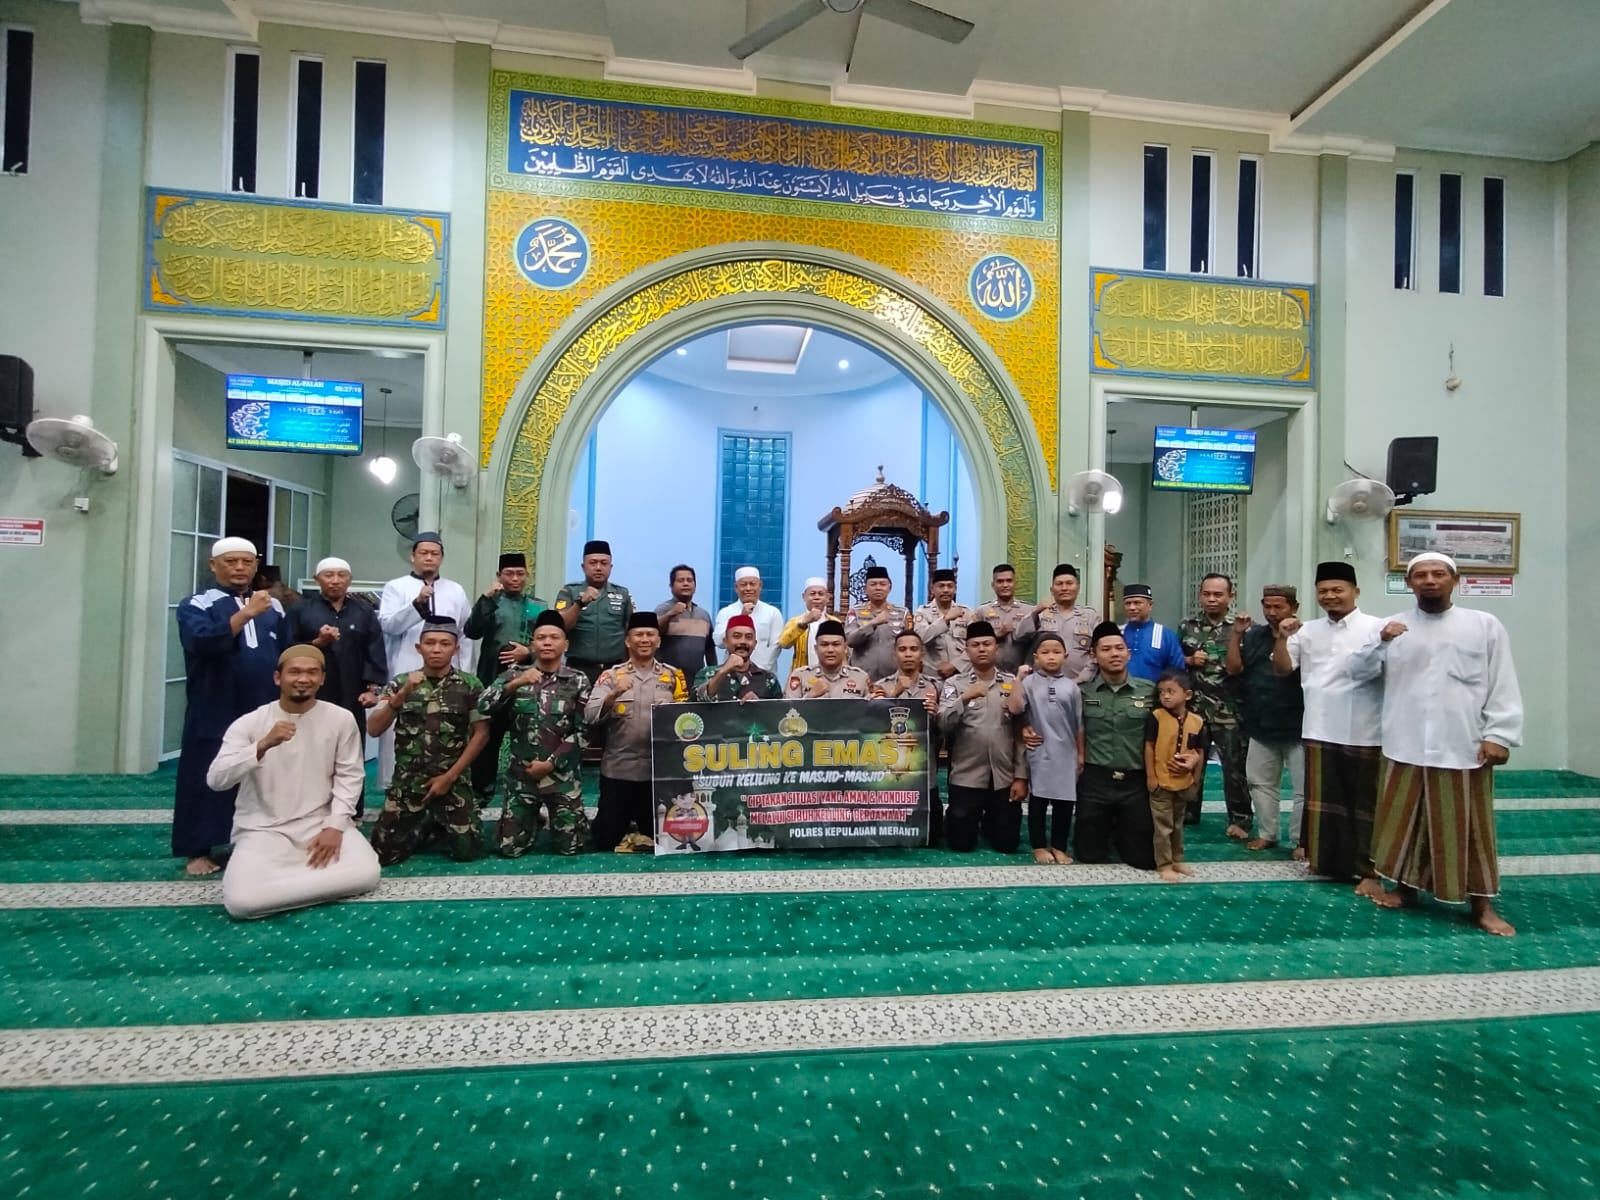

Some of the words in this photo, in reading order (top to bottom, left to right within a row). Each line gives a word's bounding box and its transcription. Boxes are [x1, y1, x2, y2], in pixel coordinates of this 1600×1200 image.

[683, 740, 804, 772] SULING
[813, 739, 899, 767] EMAS
[736, 772, 781, 787] KELILING
[783, 770, 797, 784] KE
[844, 789, 869, 804] AMAN
[869, 789, 877, 804] &
[789, 827, 823, 838] POLRES
[824, 826, 876, 837] KEPULAUAN
[878, 826, 919, 837] MERANTI
